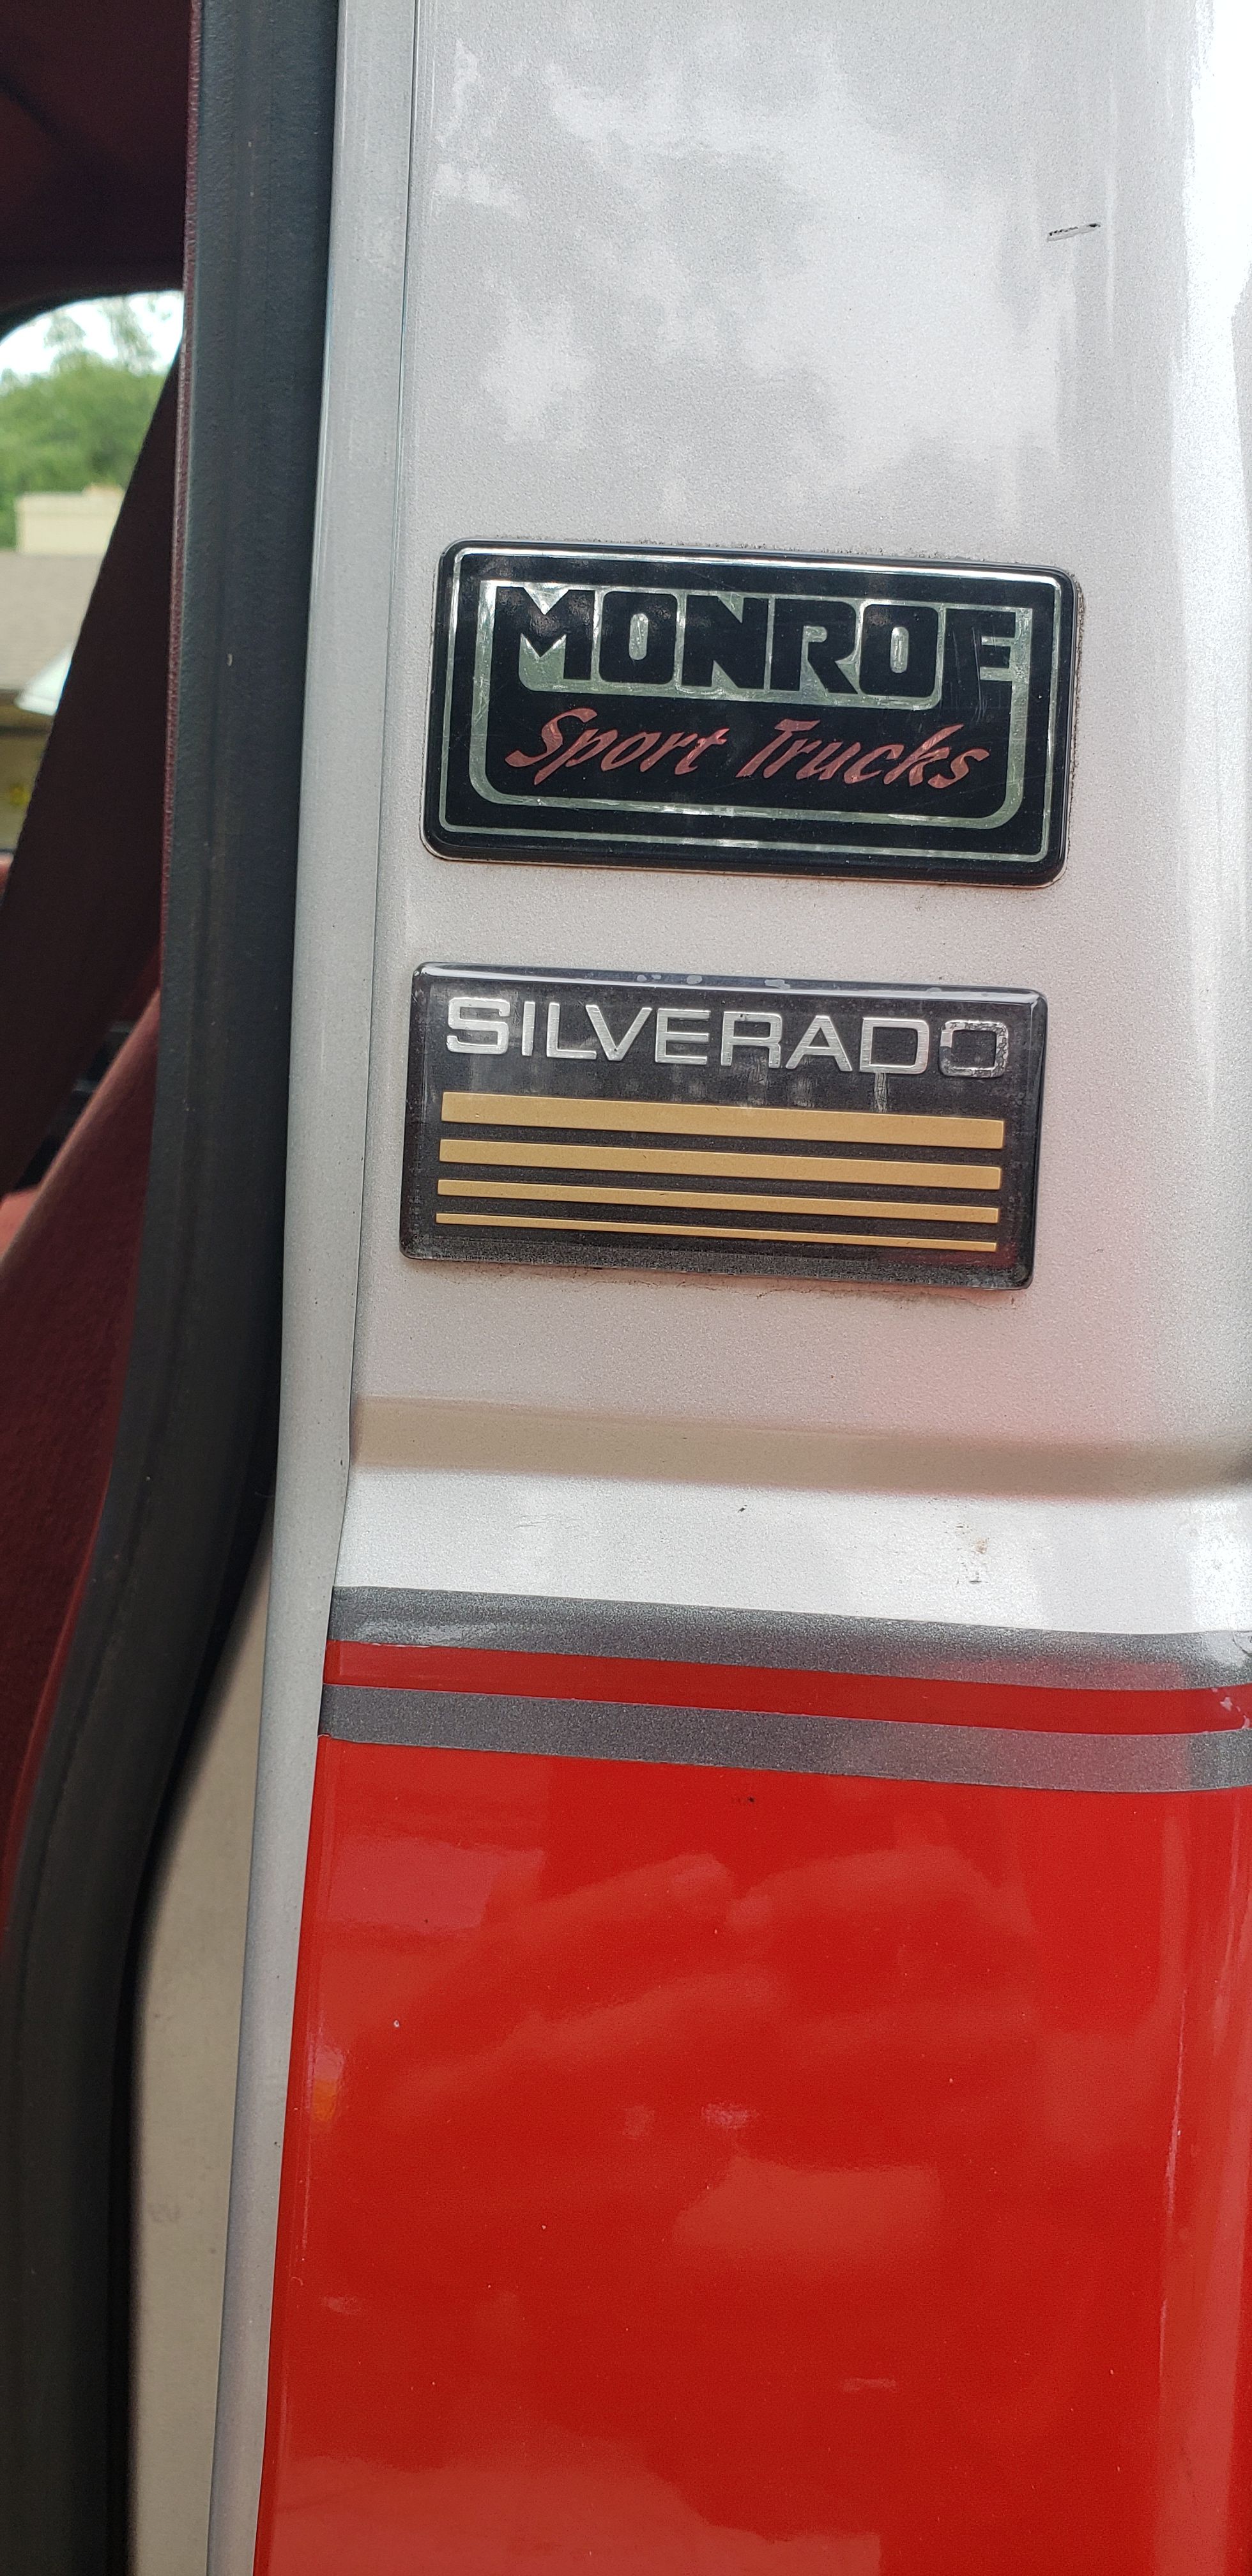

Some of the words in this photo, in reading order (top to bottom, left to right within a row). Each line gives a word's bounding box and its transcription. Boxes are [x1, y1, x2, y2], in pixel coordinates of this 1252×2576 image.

[495, 584, 1017, 702] MONROE
[505, 707, 729, 785] Sport
[736, 719, 991, 789] Trucks
[447, 997, 1009, 1078] SILVERADO
